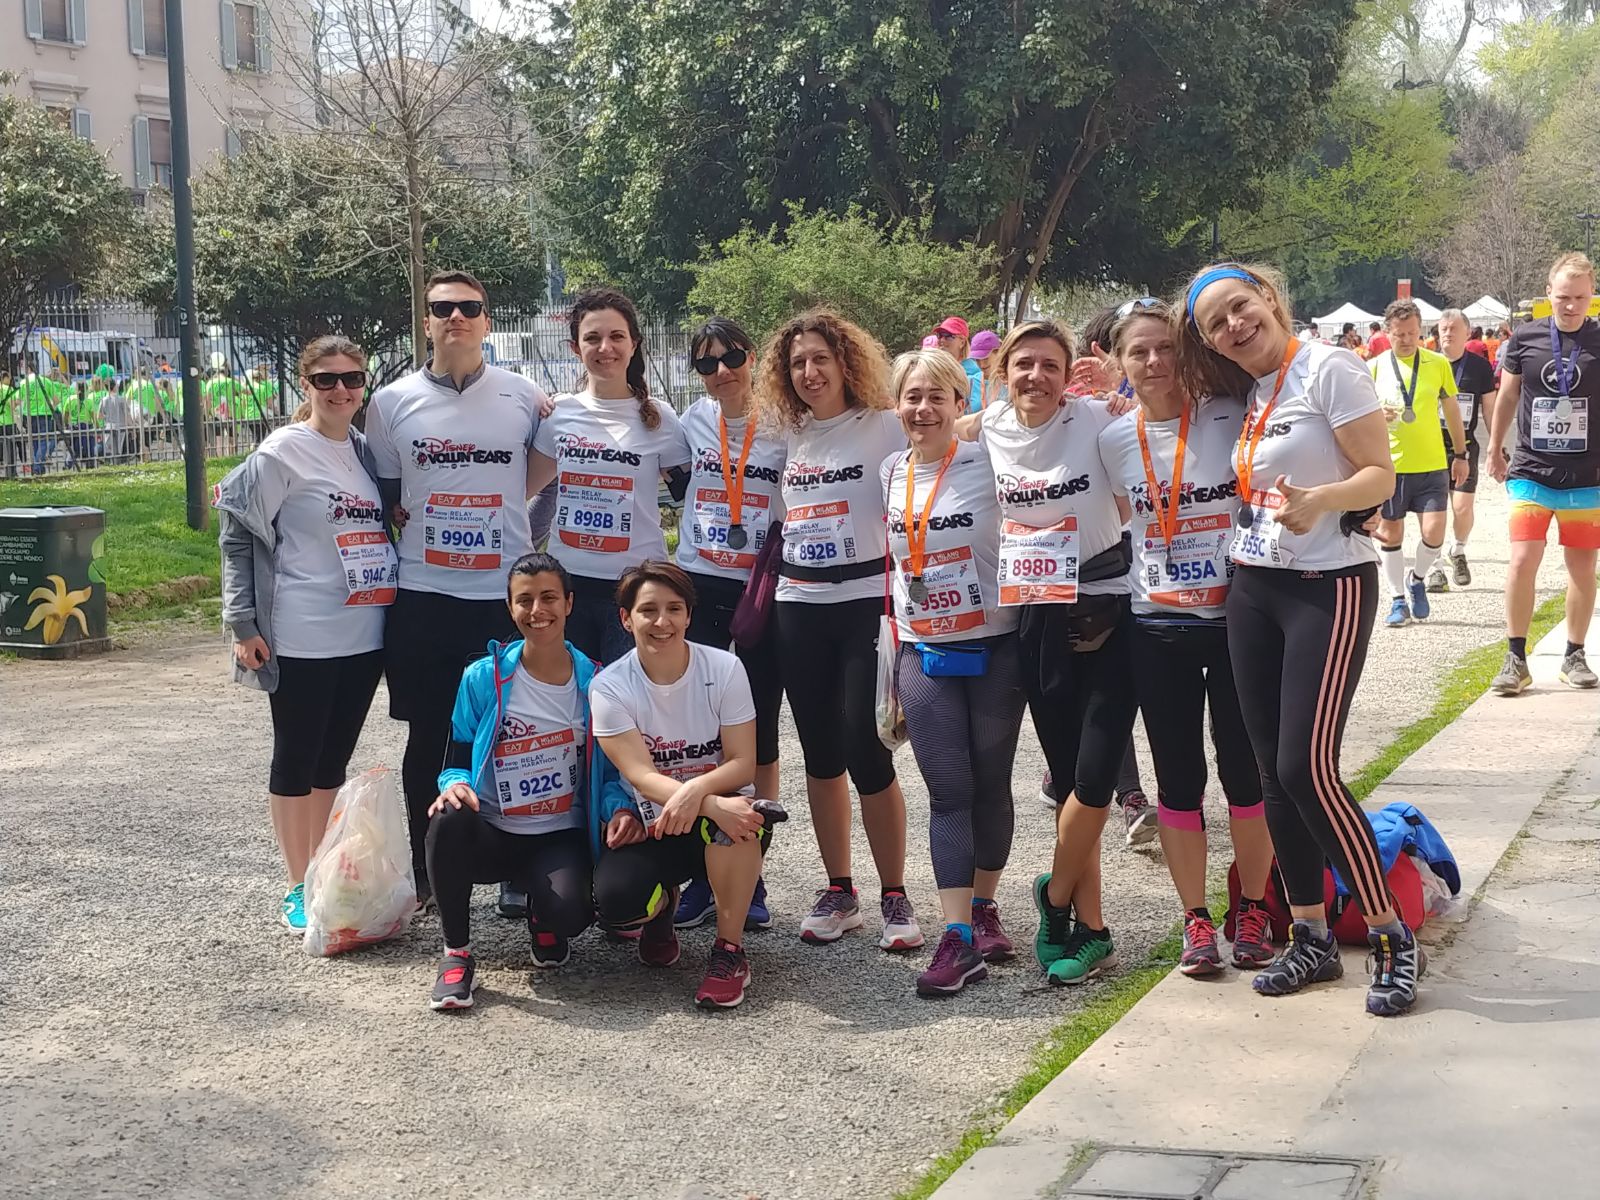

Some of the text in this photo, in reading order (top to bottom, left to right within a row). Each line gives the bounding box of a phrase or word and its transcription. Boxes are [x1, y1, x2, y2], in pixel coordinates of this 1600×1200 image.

[1547, 422, 1572, 435] 507
[1547, 439, 1570, 448] EA7
[428, 450, 513, 464] VOLUNTEARS
[564, 448, 642, 466] VOLUNTEARS
[786, 464, 864, 487] VOLUNTEARS
[1004, 474, 1090, 504] VOLUNTEARS
[438, 496, 456, 504] EA7
[574, 510, 614, 528] 898B
[442, 530, 486, 547] 990A
[580, 534, 605, 548] EA7
[708, 526, 728, 544] 95
[1172, 537, 1196, 546] RELAY
[800, 542, 838, 560] 892B
[1172, 542, 1210, 552] MARATHON
[1240, 534, 1266, 558] 955C
[448, 554, 476, 566] EA7
[712, 551, 738, 564] EA7
[1012, 558, 1057, 576] 898D
[1170, 559, 1218, 582] 955A
[362, 566, 386, 584] 914C
[1020, 586, 1048, 598] EA7
[1178, 590, 1209, 603] EA7
[920, 590, 962, 612] 955D
[930, 616, 958, 630] EA7
[504, 742, 522, 753] EA7
[520, 753, 544, 763] RELAY
[522, 757, 557, 768] MARATHON
[519, 772, 563, 796] 922C
[530, 798, 558, 814] EA7
